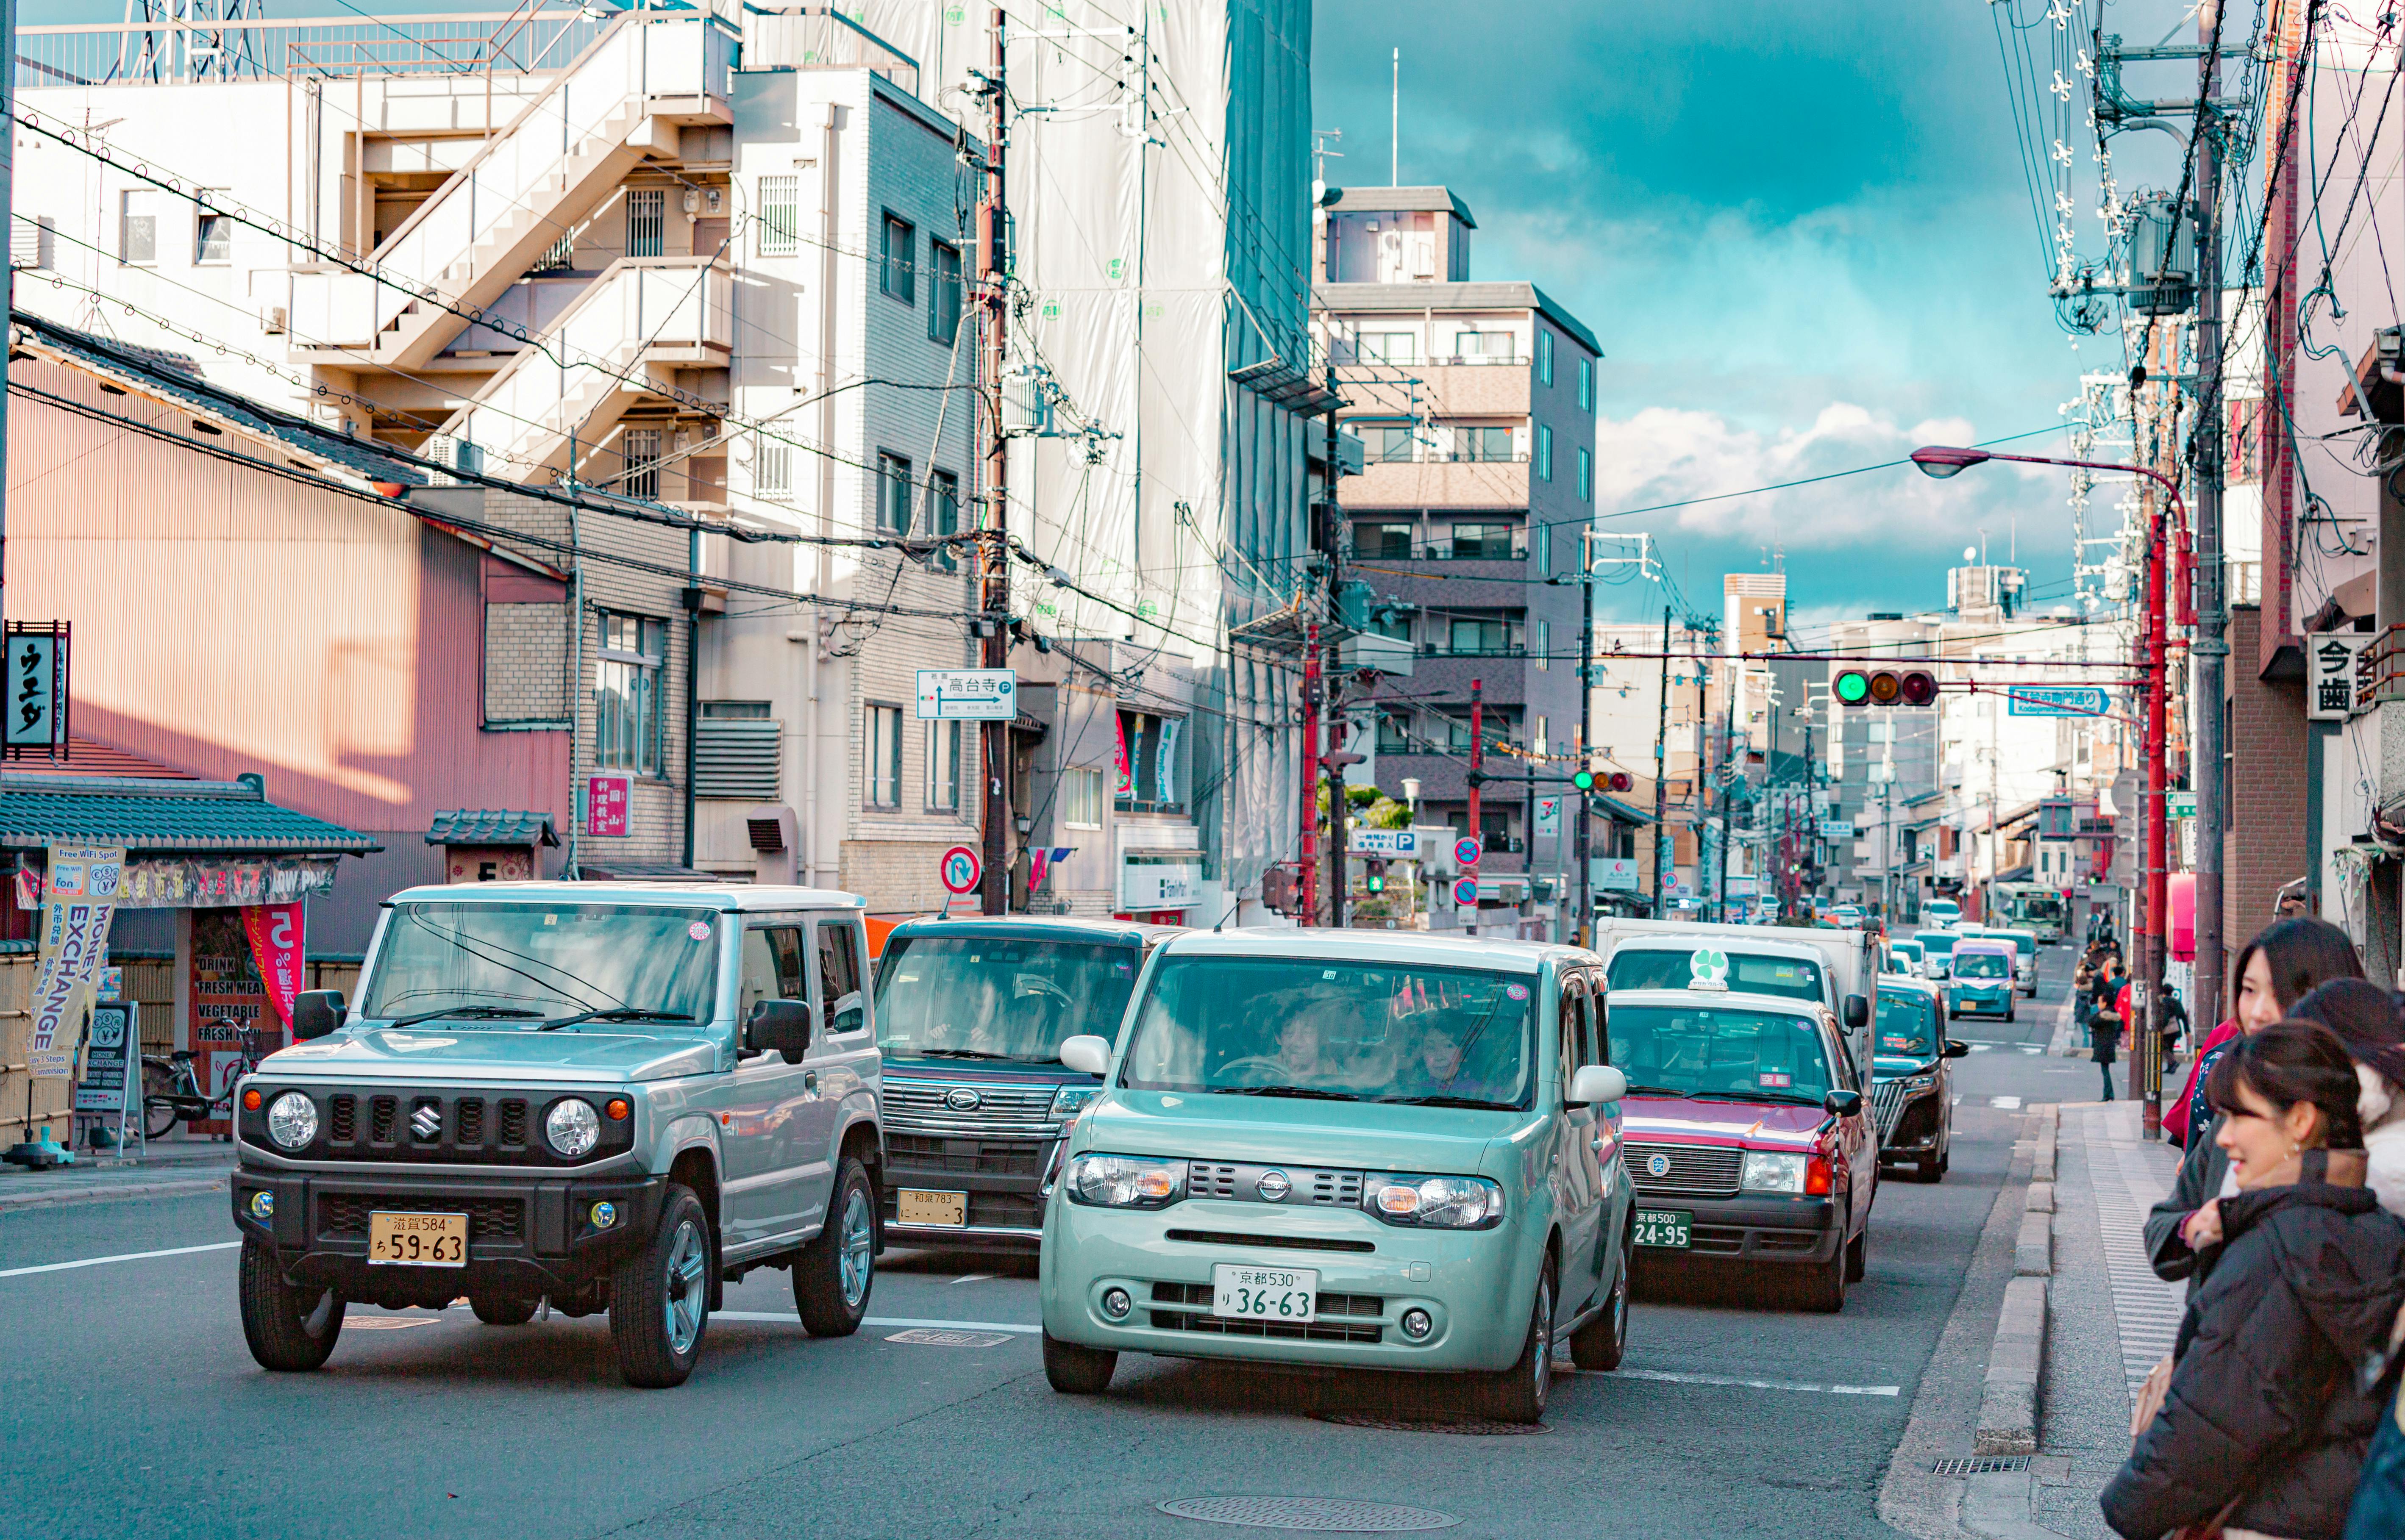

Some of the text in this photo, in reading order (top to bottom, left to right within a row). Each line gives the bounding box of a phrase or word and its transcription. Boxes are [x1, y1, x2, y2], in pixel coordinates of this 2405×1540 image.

[16, 643, 47, 735] ウエダ
[950, 677, 996, 692] 高台寺
[60, 849, 77, 857] Free
[99, 851, 117, 860] Spot
[56, 878, 73, 888] fon
[80, 905, 110, 982] MONEY
[199, 958, 235, 971] DRINK
[35, 906, 89, 1049] EXCHANGE
[199, 982, 232, 994] FRESH
[198, 1005, 259, 1017] VEGETABLE
[198, 1028, 232, 1040] FRESH
[46, 1055, 65, 1063] Steps
[1760, 1074, 1788, 1085] 空車
[1635, 1224, 1688, 1245] 24-95
[377, 1234, 462, 1260] ち 59-63
[1236, 1288, 1310, 1318] 36-63
